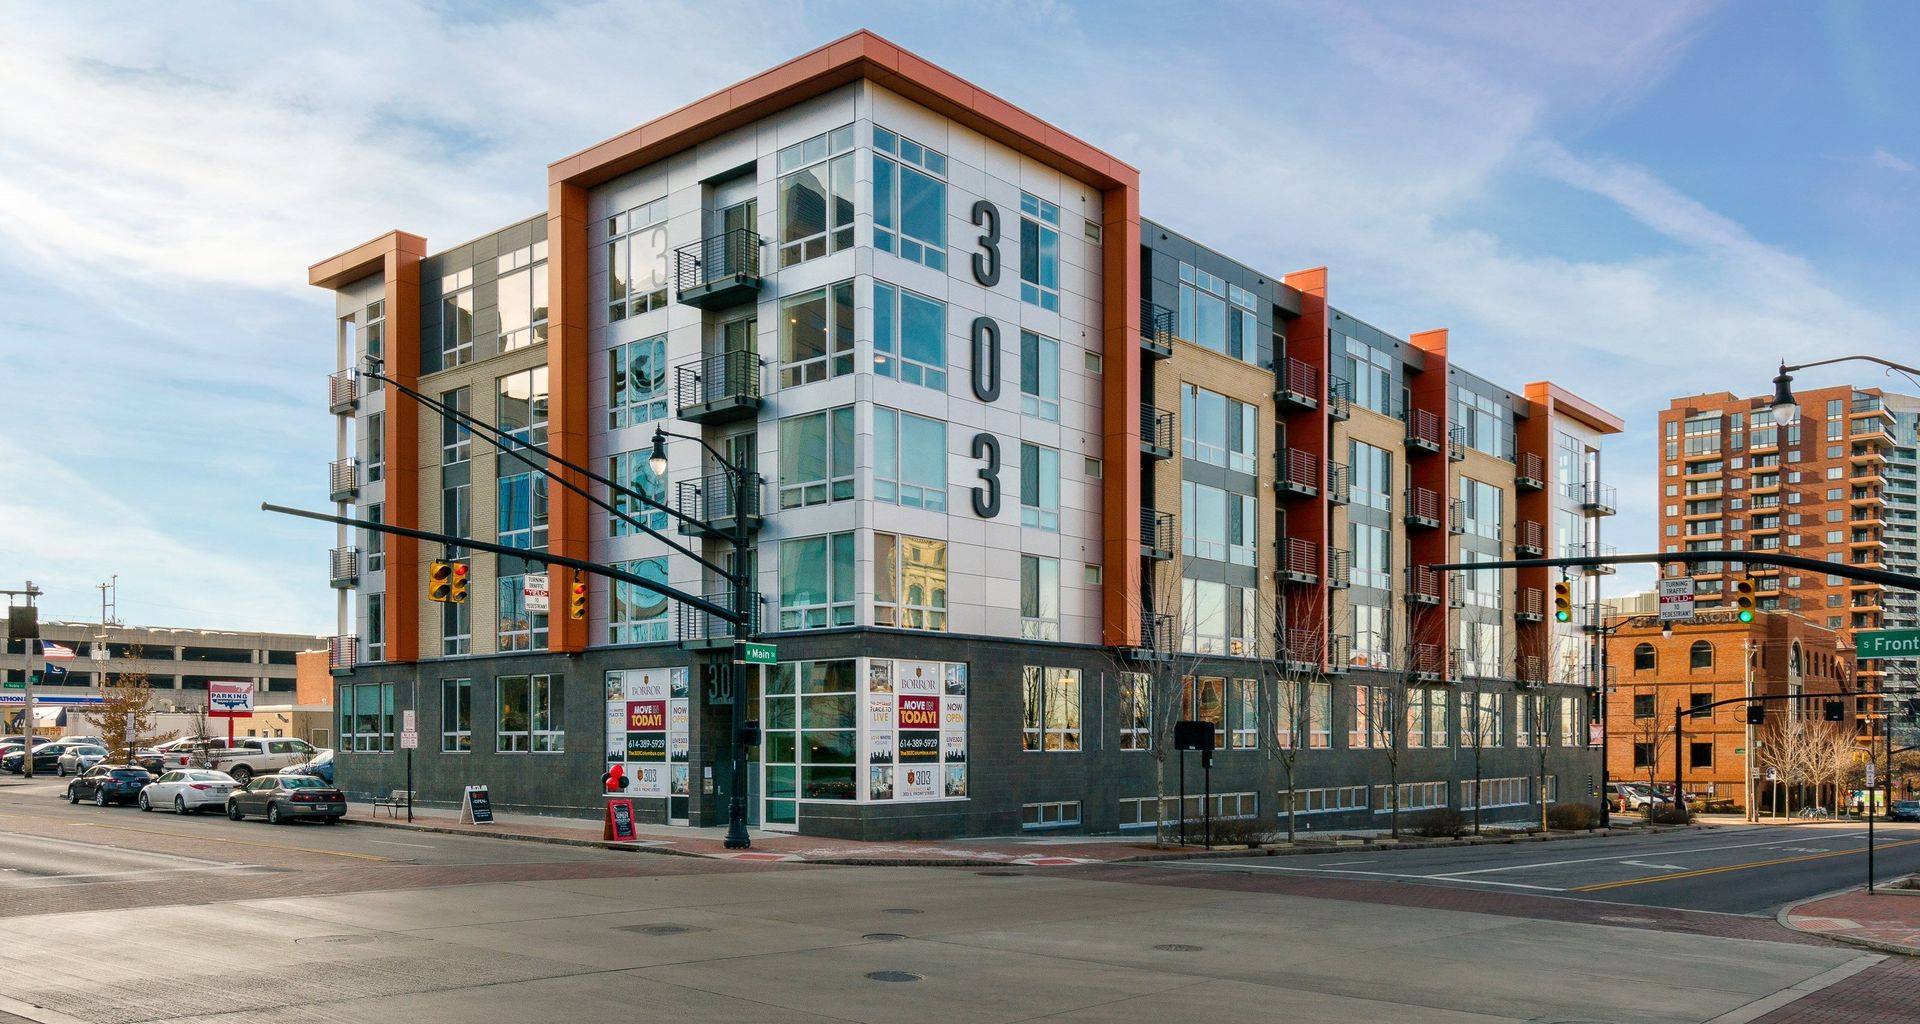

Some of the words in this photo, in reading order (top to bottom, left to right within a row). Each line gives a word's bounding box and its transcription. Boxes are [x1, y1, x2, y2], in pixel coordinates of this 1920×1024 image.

[1665, 580, 1688, 588] TURNING
[1665, 595, 1689, 603] YIELD
[1863, 640, 1870, 649] S
[1874, 636, 1920, 651] Front
[752, 648, 770, 659] Main
[901, 678, 936, 690] BORROR
[634, 705, 652, 714] MOVE
[904, 700, 925, 710] MOVE
[946, 702, 963, 712] NOW
[673, 706, 688, 715] NOW
[632, 714, 662, 726] TODAY!
[873, 712, 889, 722] LIVE
[900, 710, 937, 724] TODAY!
[945, 713, 964, 723] OPEN
[899, 738, 938, 748] 614-389-5929
[643, 768, 657, 782] 303
[916, 770, 931, 785] 303
